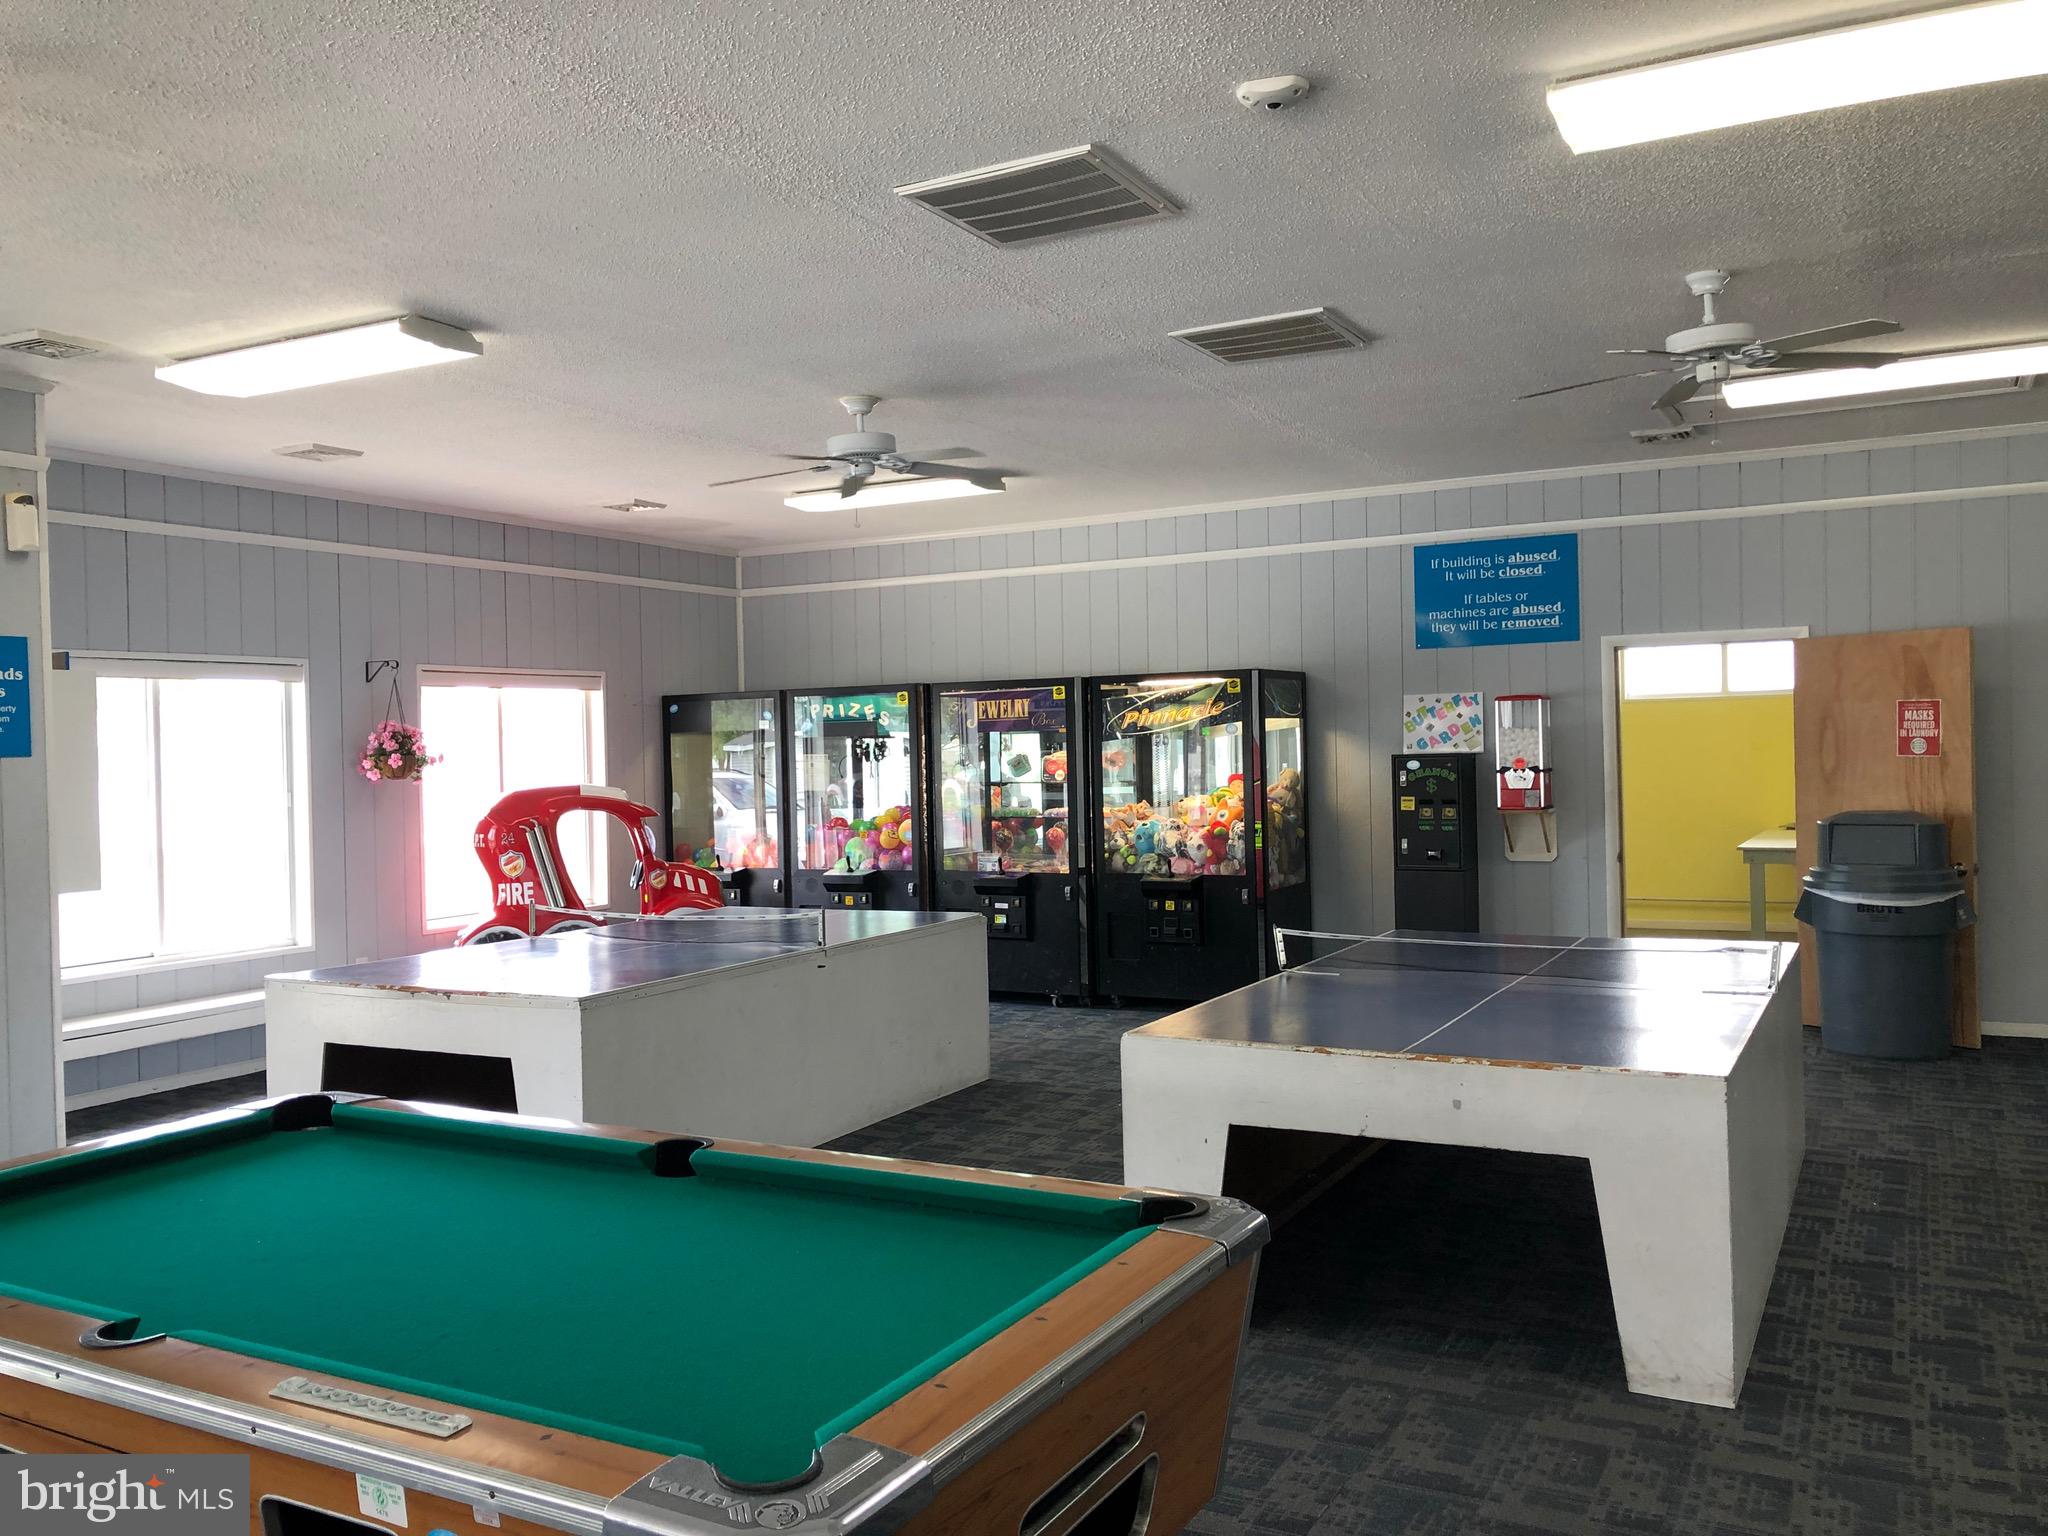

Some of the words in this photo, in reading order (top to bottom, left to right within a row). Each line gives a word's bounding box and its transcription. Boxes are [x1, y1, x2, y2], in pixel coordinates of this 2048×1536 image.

[1431, 559, 1440, 569] If
[1442, 556, 1491, 568] building
[1494, 554, 1505, 564] is
[1445, 571, 1454, 581] It
[1457, 569, 1477, 580] will
[1480, 568, 1496, 579] be
[1499, 564, 1546, 579] closed.
[1464, 594, 1474, 604] If
[1475, 592, 1513, 604] tables
[1515, 592, 1529, 601] or
[1429, 608, 1487, 620] machines
[1489, 607, 1510, 616] are
[1512, 601, 1566, 616] abused,
[1431, 622, 1457, 634] they
[1459, 620, 1480, 631] will
[1483, 619, 1499, 630] be
[1501, 615, 1564, 630] removed.
[810, 702, 890, 726] PRIZES
[966, 698, 1031, 729] JEWELRY
[1120, 697, 1226, 730] Pinnacle
[1404, 693, 1480, 733] BUTTERFLY
[1904, 710, 1935, 721] MASKS
[1416, 714, 1482, 750] GARDEN
[1900, 729, 1908, 737] IN
[1909, 728, 1939, 737] LAUNDRY
[1903, 720, 1936, 729] REQUIRED
[501, 832, 515, 844] 24
[496, 881, 535, 906] FIRE
[1856, 903, 1905, 914] BRUTE
[649, 1476, 745, 1509] VALLEY
